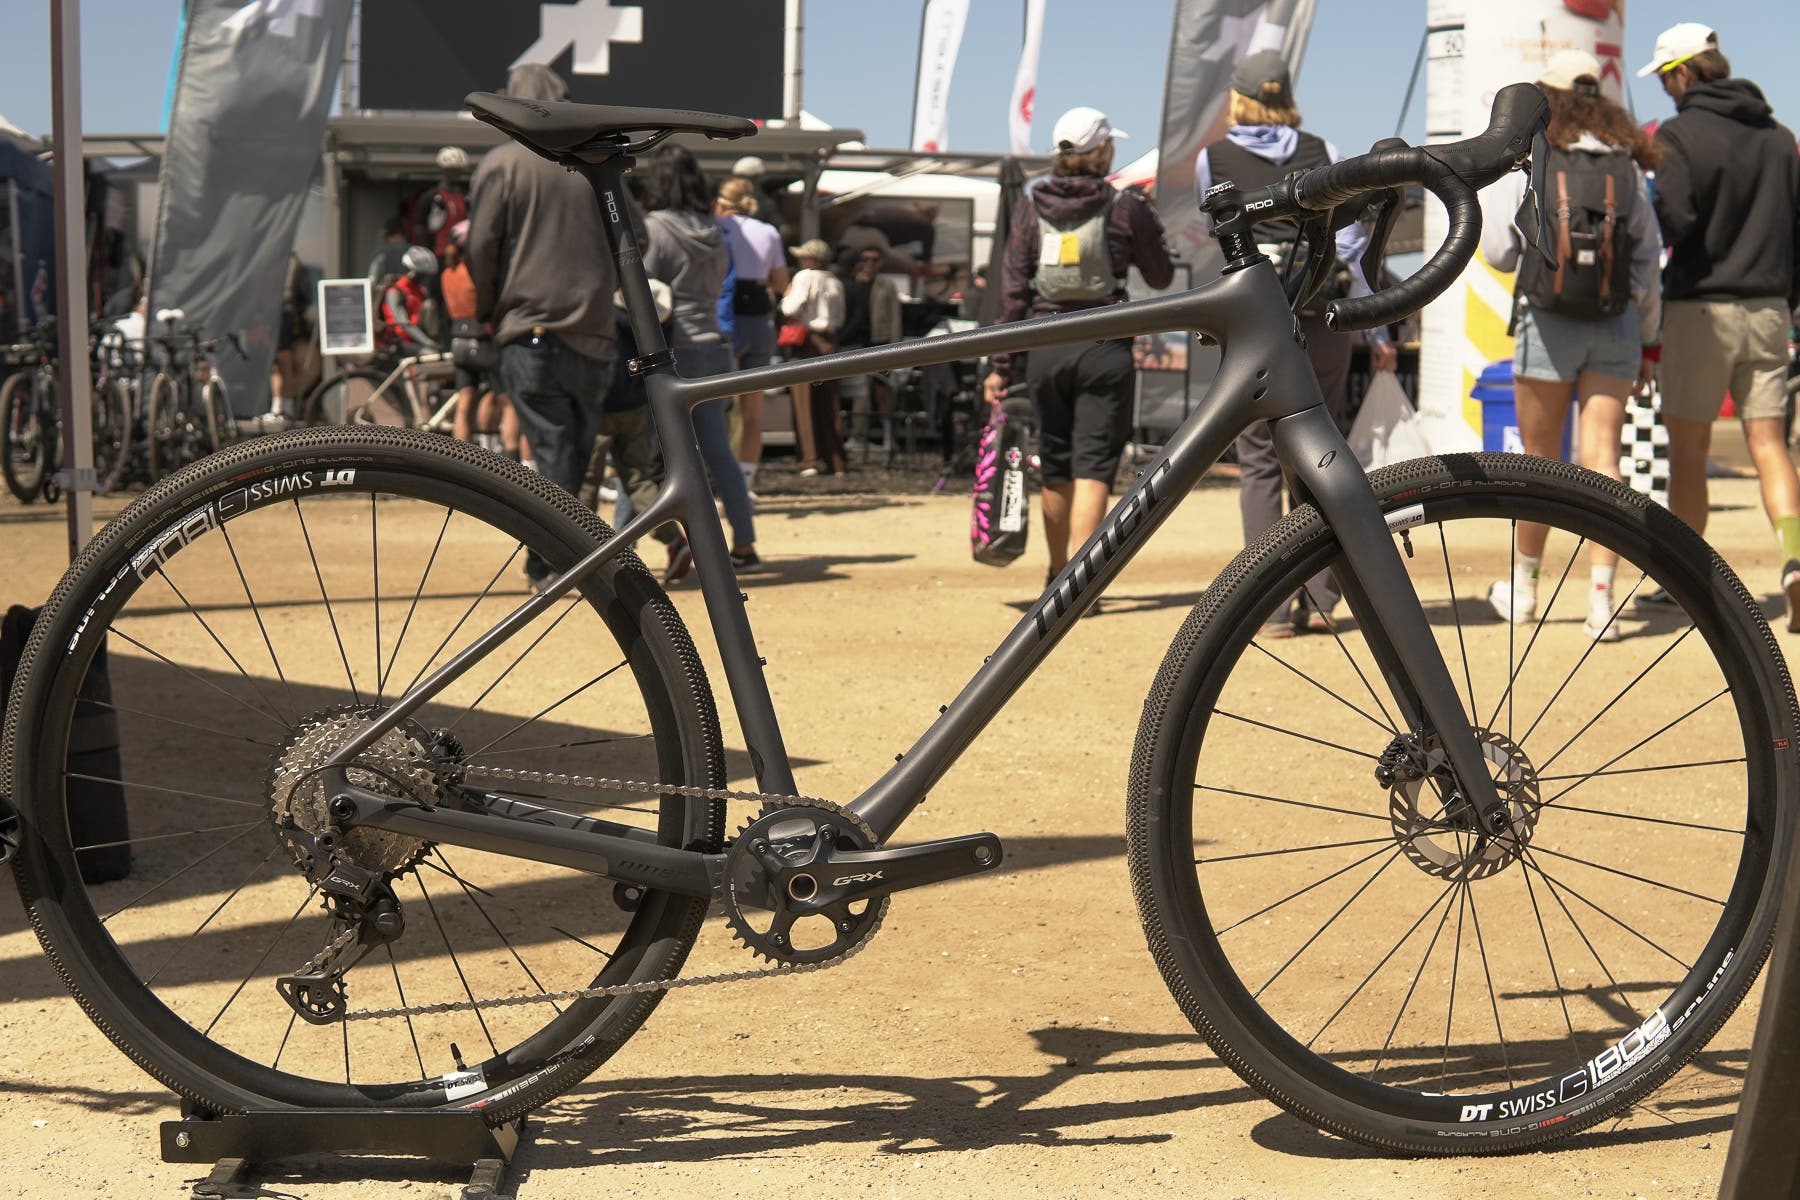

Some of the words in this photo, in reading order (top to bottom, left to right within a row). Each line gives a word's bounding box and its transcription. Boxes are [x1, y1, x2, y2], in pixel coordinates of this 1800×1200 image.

[604, 191, 620, 223] RDO
[1245, 199, 1274, 212] RDO
[250, 471, 313, 501] SWISS
[320, 468, 356, 487] DT
[124, 494, 202, 549] SCHWALBE
[1032, 458, 1171, 640] niner
[330, 876, 360, 890] GRX
[833, 871, 883, 886] GRX
[447, 1081, 459, 1090] DT
[1597, 1054, 1671, 1105] SCHWALBE
[1459, 1103, 1494, 1122] DT
[1499, 1090, 1556, 1119] SWISS
